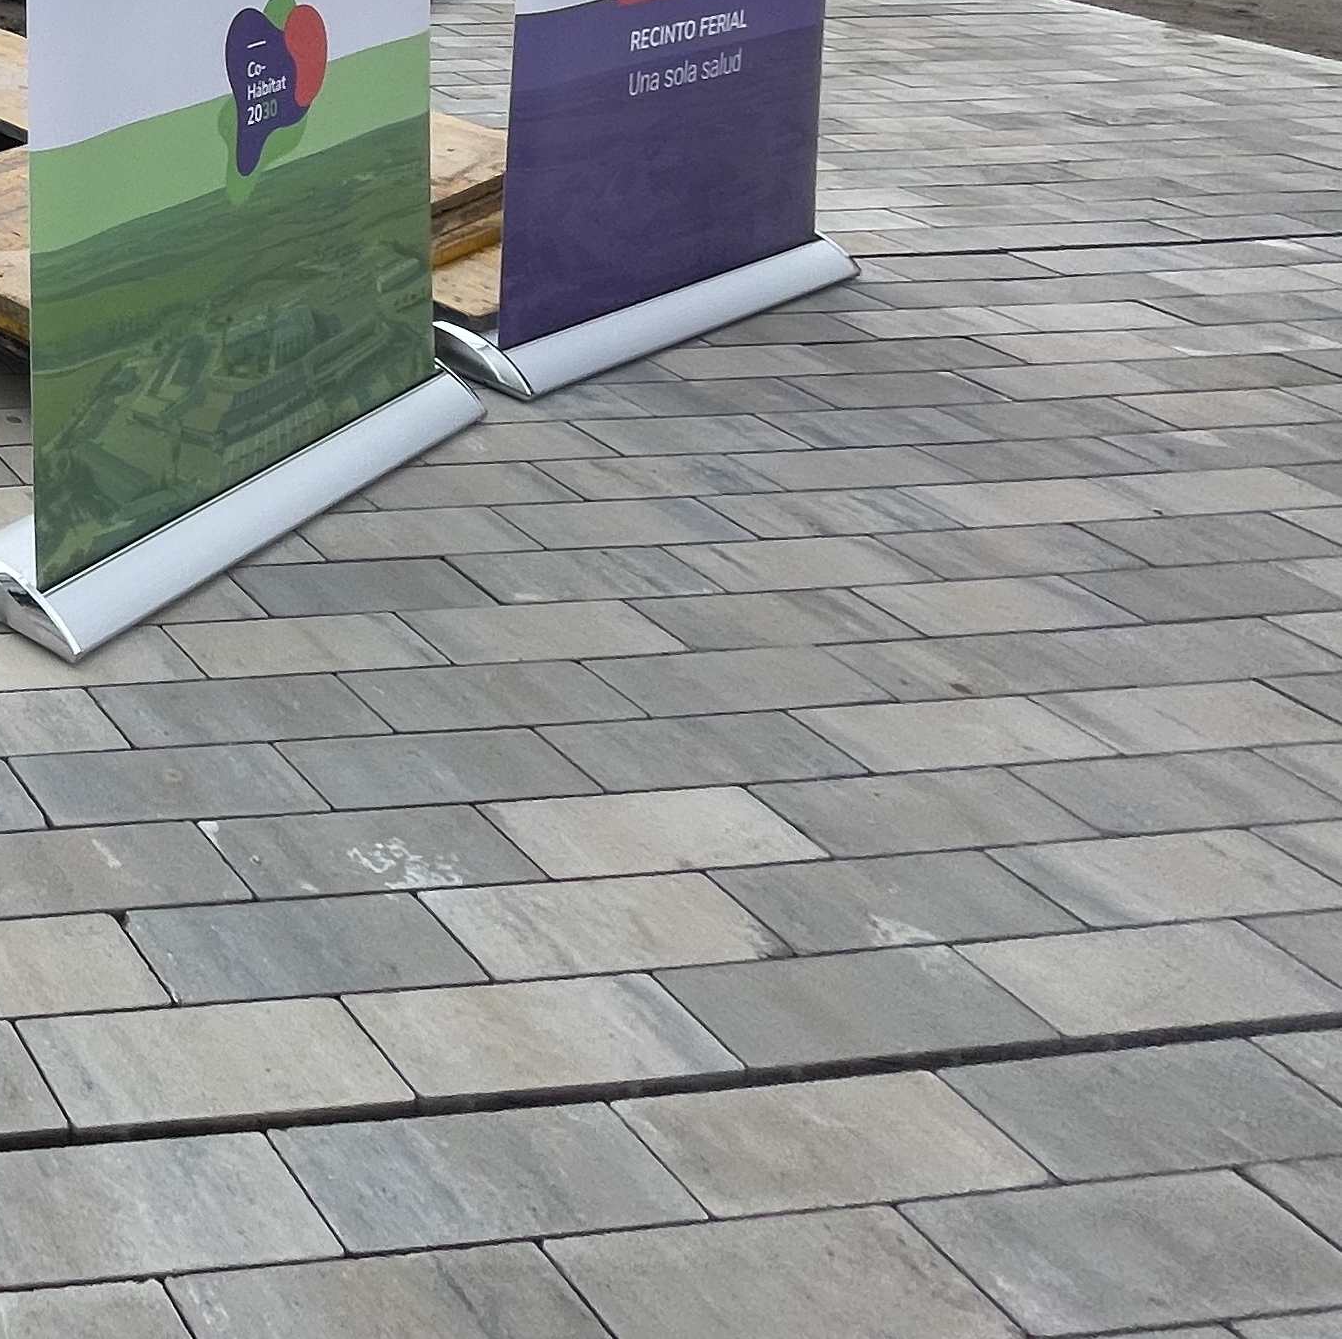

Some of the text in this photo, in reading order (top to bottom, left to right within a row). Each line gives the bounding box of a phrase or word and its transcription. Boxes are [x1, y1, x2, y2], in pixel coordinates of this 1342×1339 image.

[630, 9, 748, 52] RECINTO FERIAL
[246, 60, 266, 79] Co-
[629, 48, 742, 96] Una sola salud
[246, 75, 287, 101] Hábitat
[246, 98, 278, 126] 2030
